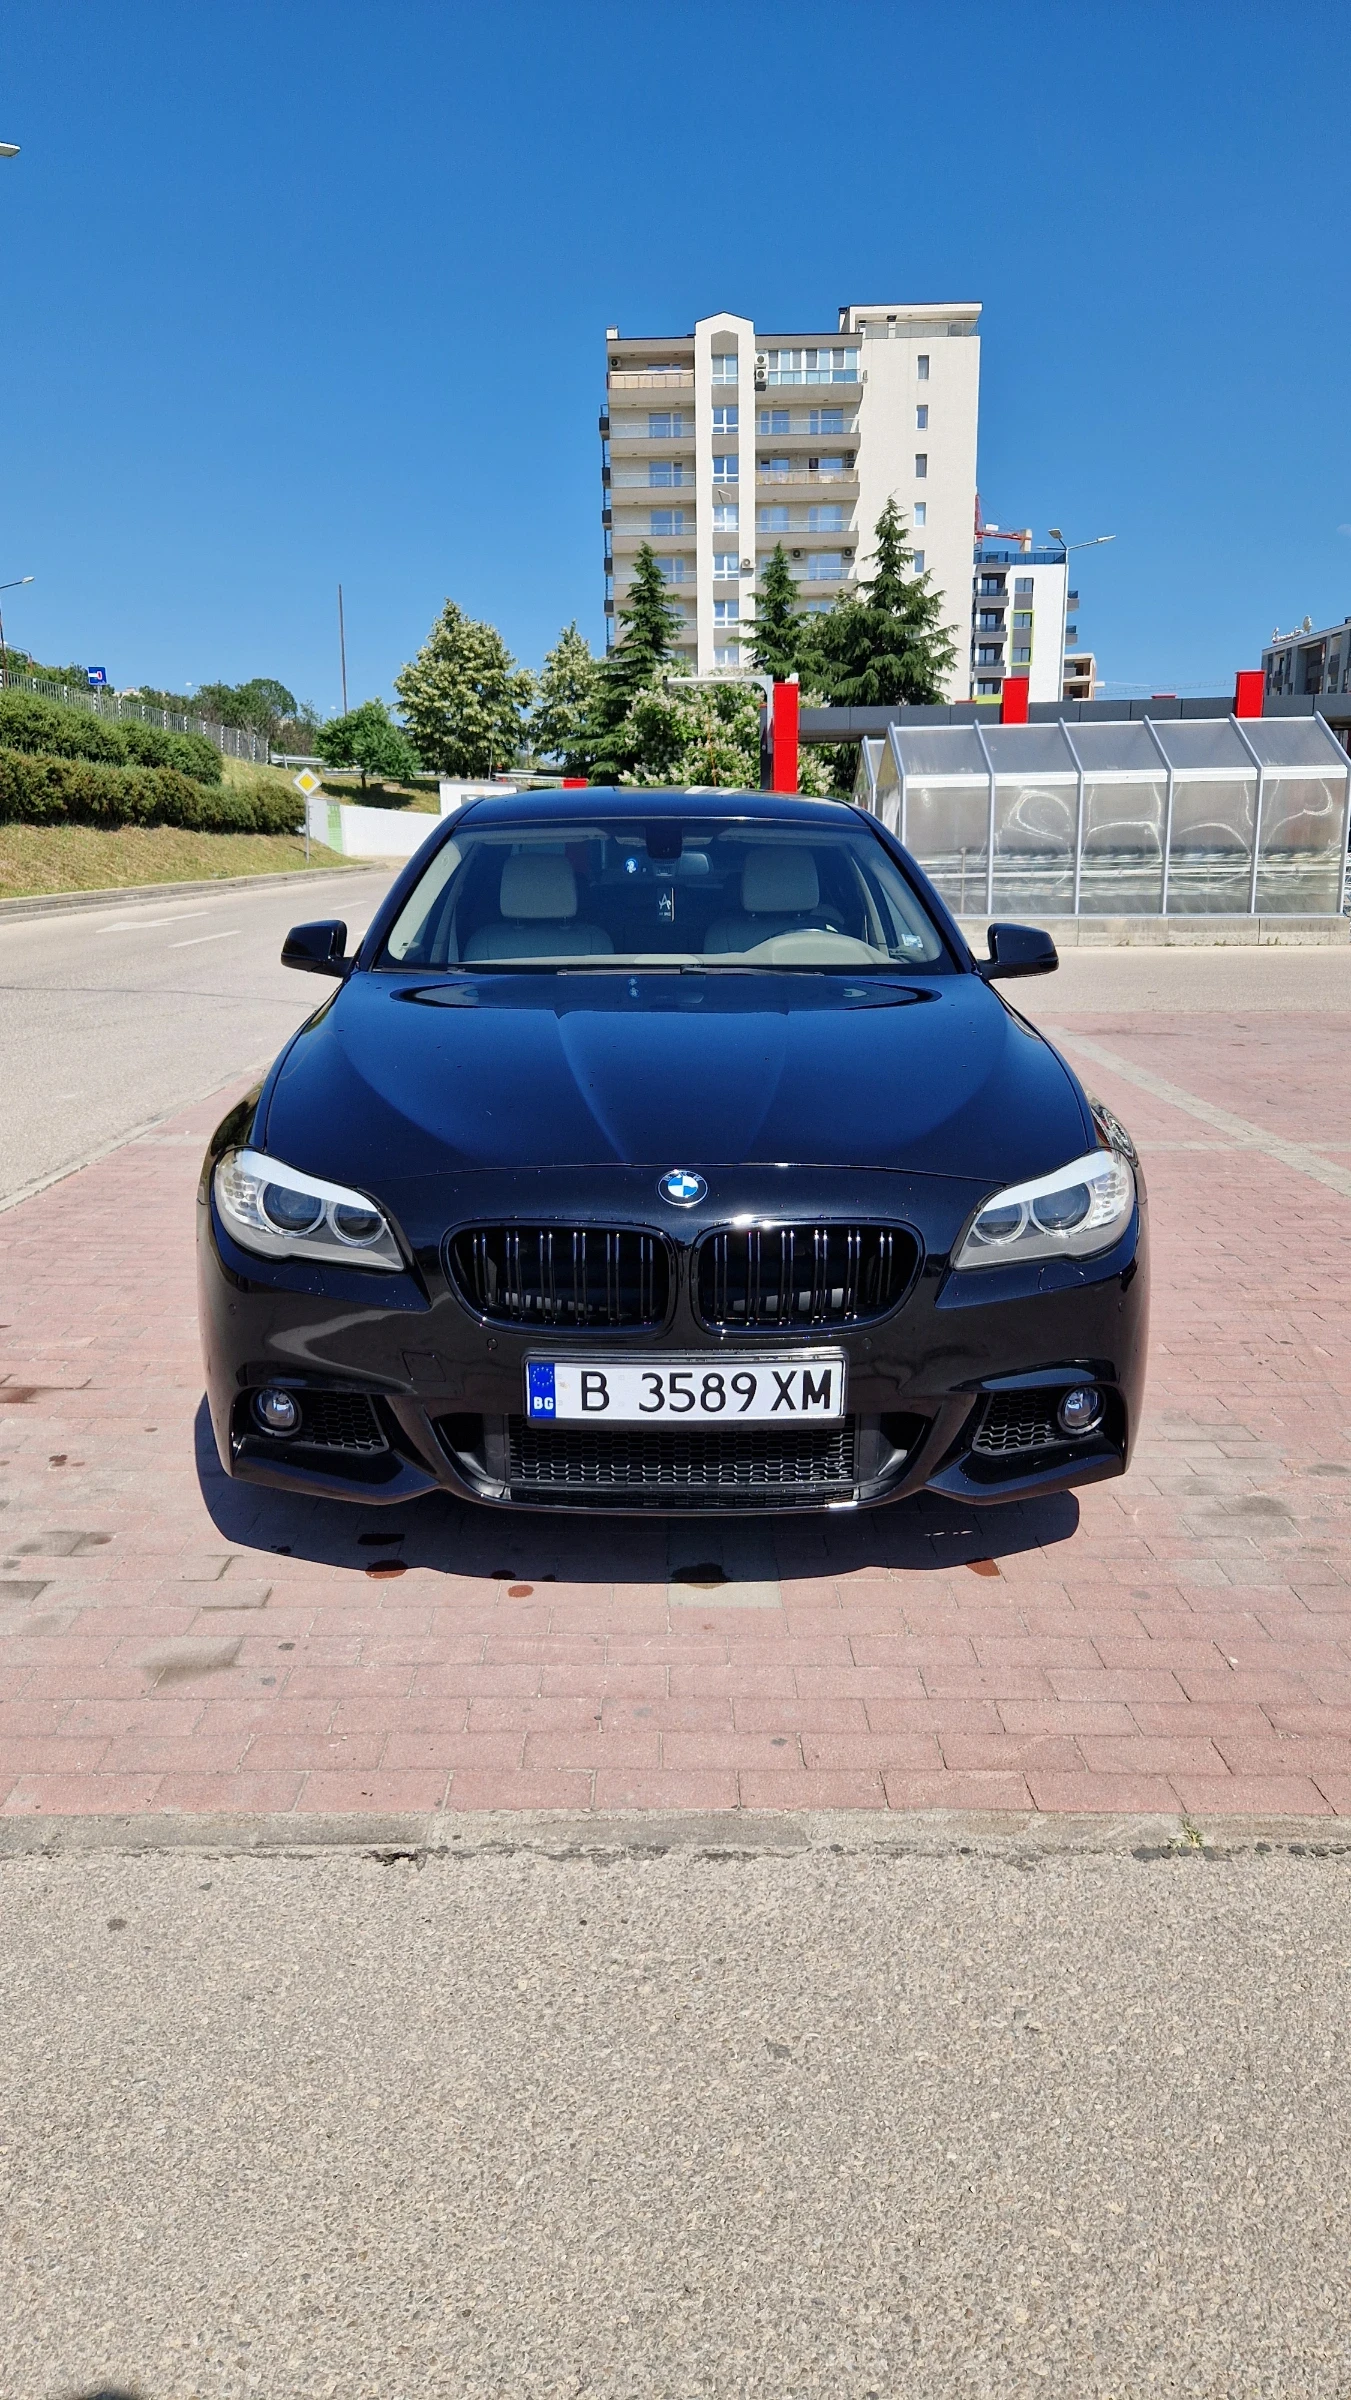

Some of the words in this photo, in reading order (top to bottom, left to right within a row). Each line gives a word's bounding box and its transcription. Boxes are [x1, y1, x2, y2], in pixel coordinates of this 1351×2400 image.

[533, 1396, 554, 1410] BG
[580, 1370, 610, 1411] B
[638, 1371, 758, 1413] 3589
[770, 1369, 832, 1411] XM
